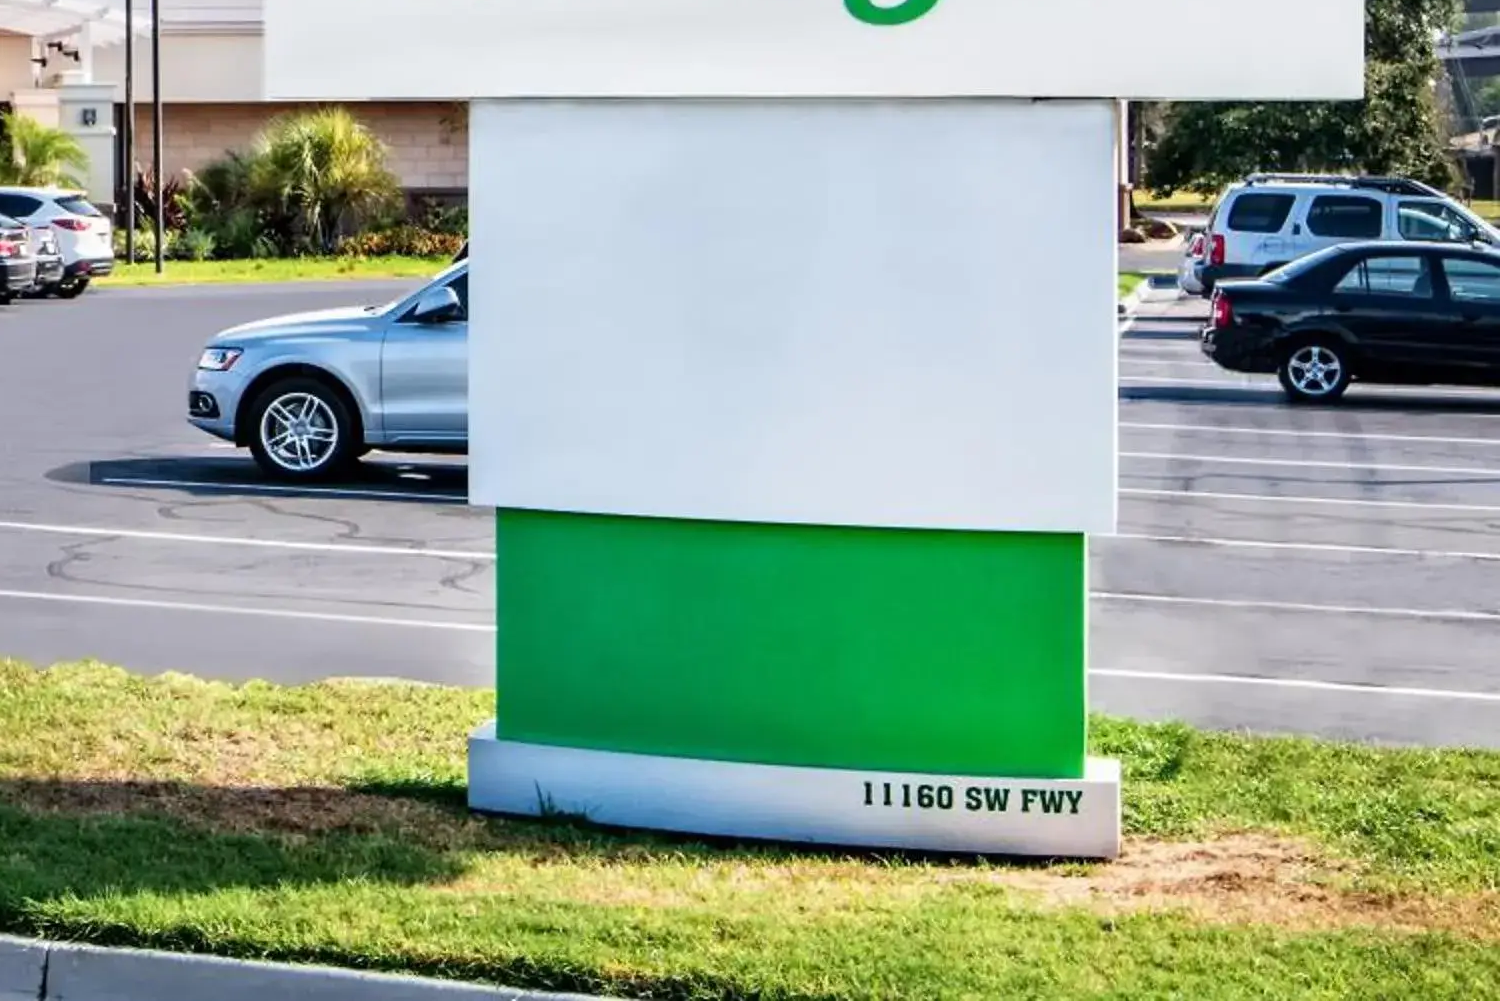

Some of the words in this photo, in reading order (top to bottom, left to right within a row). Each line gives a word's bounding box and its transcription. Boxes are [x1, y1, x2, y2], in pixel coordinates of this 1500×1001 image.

[862, 781, 953, 810] 11160
[964, 786, 1011, 812] SW
[1020, 788, 1084, 815] FWY
